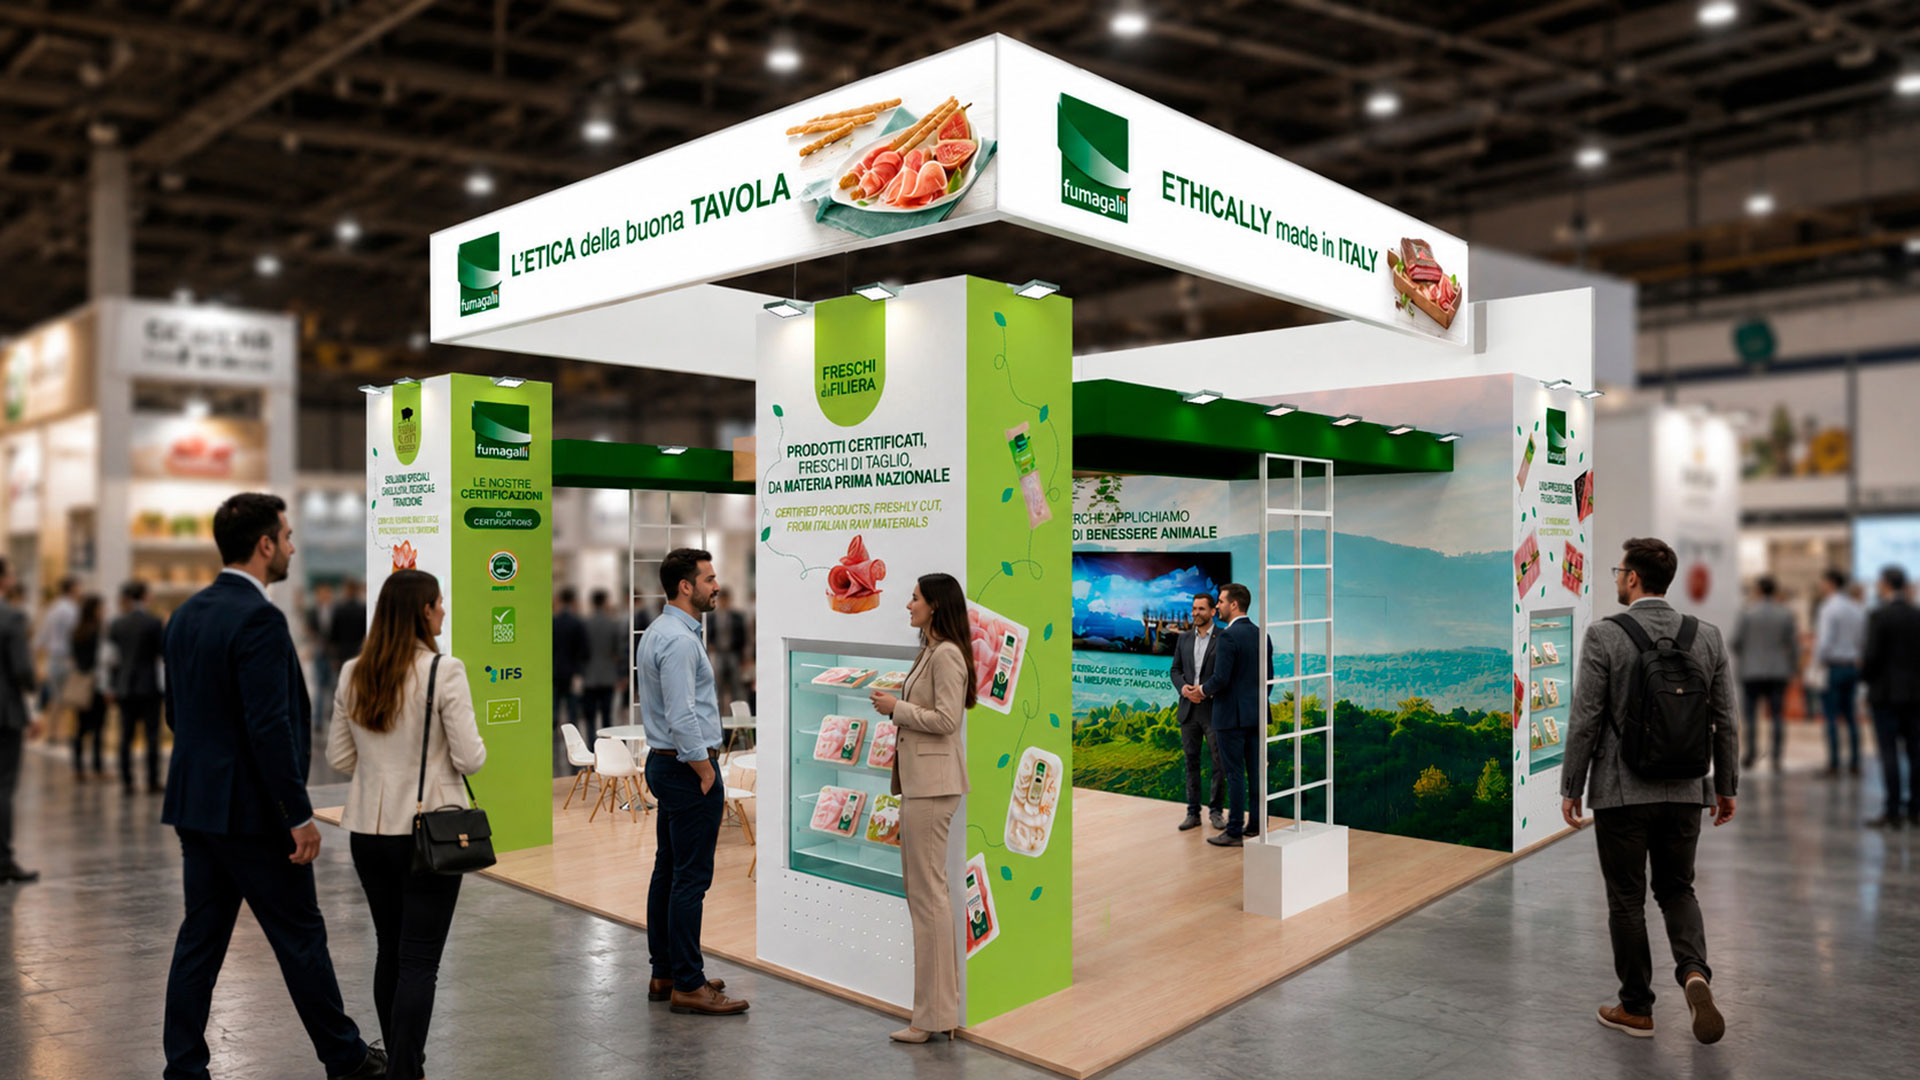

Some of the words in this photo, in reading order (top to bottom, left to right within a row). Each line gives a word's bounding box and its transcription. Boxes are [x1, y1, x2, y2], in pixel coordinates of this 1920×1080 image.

[1062, 178, 1126, 216] fumagalli
[580, 226, 621, 257] della
[626, 209, 685, 244] buona
[690, 172, 792, 225] TAVOLA
[1162, 170, 1272, 235] ETHICALLY
[1276, 219, 1318, 252] made
[1322, 231, 1334, 258] in
[1338, 237, 1378, 273] ITALY
[460, 289, 499, 313] fumagalli
[822, 359, 876, 380] FRESCHI
[476, 443, 529, 459] fumagalli
[787, 440, 845, 458] PRODOTTI
[849, 432, 927, 453] CERTIFICATI,
[799, 459, 848, 475] FRESCHI
[851, 456, 862, 470] DI
[866, 452, 912, 469] TAGLIO,
[473, 477, 486, 487] LE
[489, 478, 532, 489] NOSTRE
[768, 481, 782, 494] DA
[784, 477, 832, 493] MATERIA
[835, 474, 873, 489] PRIMA
[876, 467, 950, 487] NAZIONALE
[460, 489, 543, 501] CERTIFICAZIONI
[775, 505, 818, 519] CERTIFIED
[819, 503, 872, 517] PRODUCTS,
[873, 500, 918, 514] FRESHLY
[919, 499, 943, 513] CUT,
[1107, 510, 1190, 524] APPLICHIAMO
[786, 521, 812, 532] FROM
[814, 518, 848, 531] ITALIAN
[849, 518, 871, 530] RAW
[872, 516, 929, 529] MATERIALS
[1086, 527, 1158, 541] BENESSERE
[1160, 525, 1218, 539] ANIMALE
[500, 667, 523, 680] IFS
